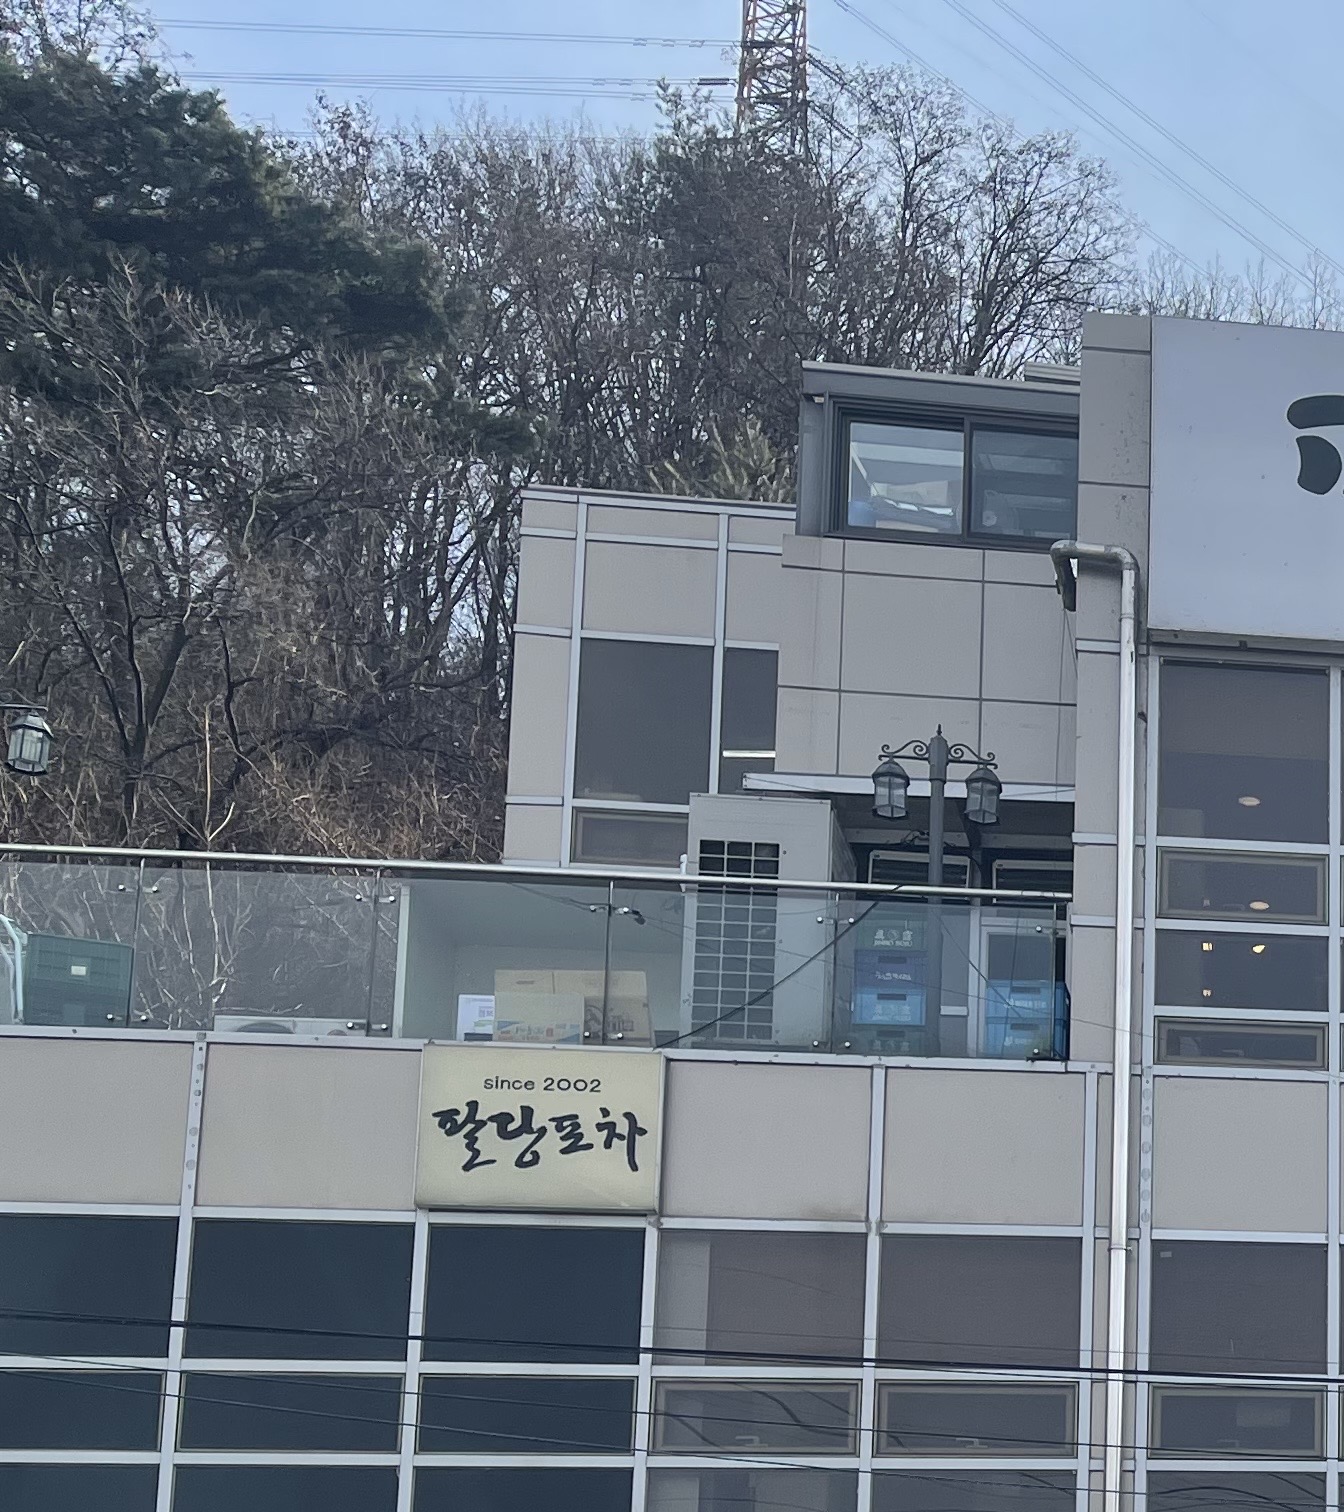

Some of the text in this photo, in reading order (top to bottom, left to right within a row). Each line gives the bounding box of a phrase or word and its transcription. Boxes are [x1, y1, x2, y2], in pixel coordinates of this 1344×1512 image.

[484, 1076, 601, 1093] since 2002
[432, 1100, 648, 1172] 팔당포차
